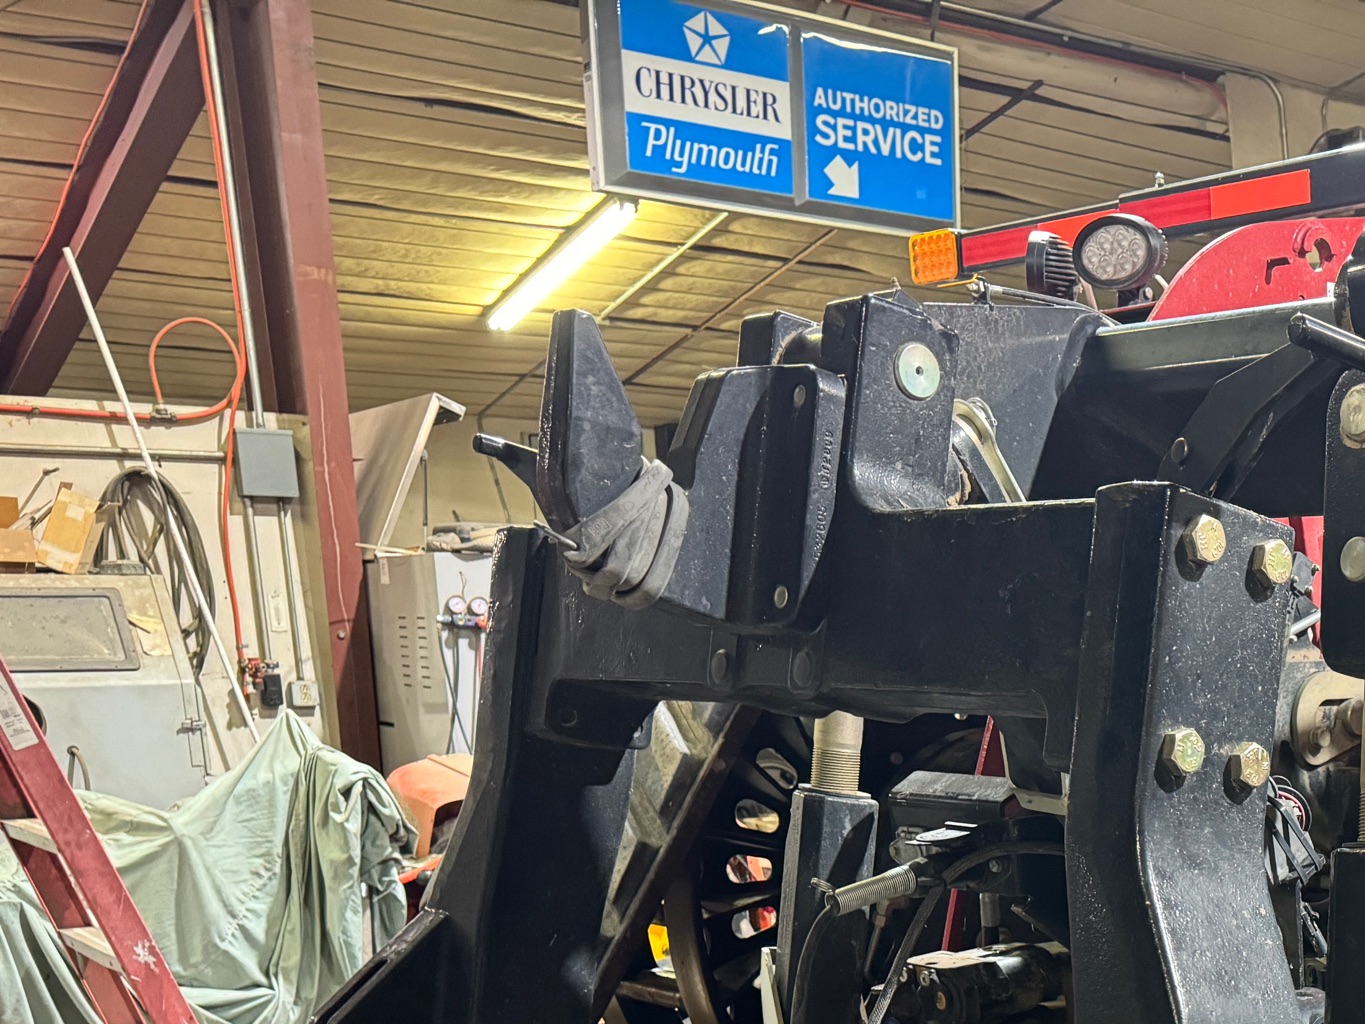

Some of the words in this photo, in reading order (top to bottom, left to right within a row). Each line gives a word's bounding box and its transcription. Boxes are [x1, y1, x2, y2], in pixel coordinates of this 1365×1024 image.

[634, 66, 782, 124] CHRYSLER
[813, 86, 944, 130] AUTHORIZED
[641, 121, 779, 177] Plymouth
[815, 114, 943, 166] SERVICE
